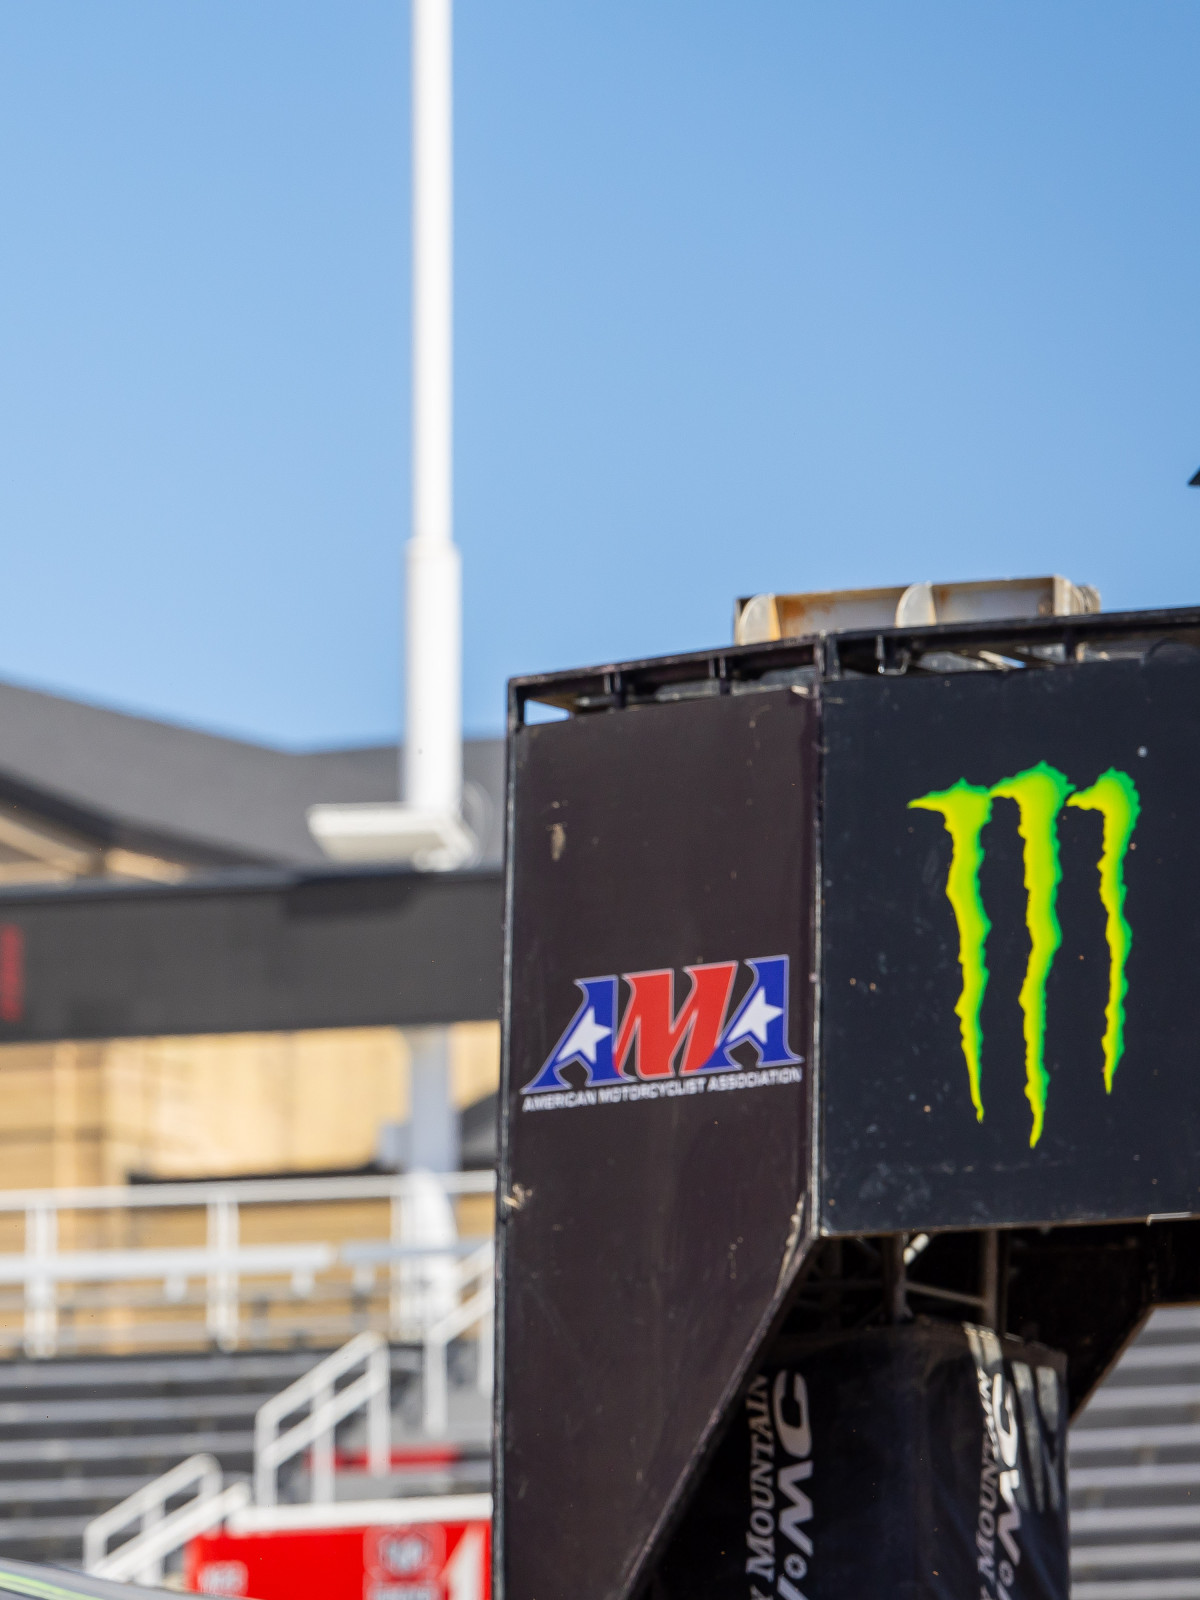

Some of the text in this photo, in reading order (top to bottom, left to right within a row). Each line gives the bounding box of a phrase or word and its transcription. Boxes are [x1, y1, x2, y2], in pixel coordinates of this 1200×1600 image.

[519, 953, 805, 1096] AMA
[522, 1067, 803, 1112] AMERICAN MOTORCYCLIST ASSOCIATION
[745, 1374, 776, 1583] MOUNTAIN
